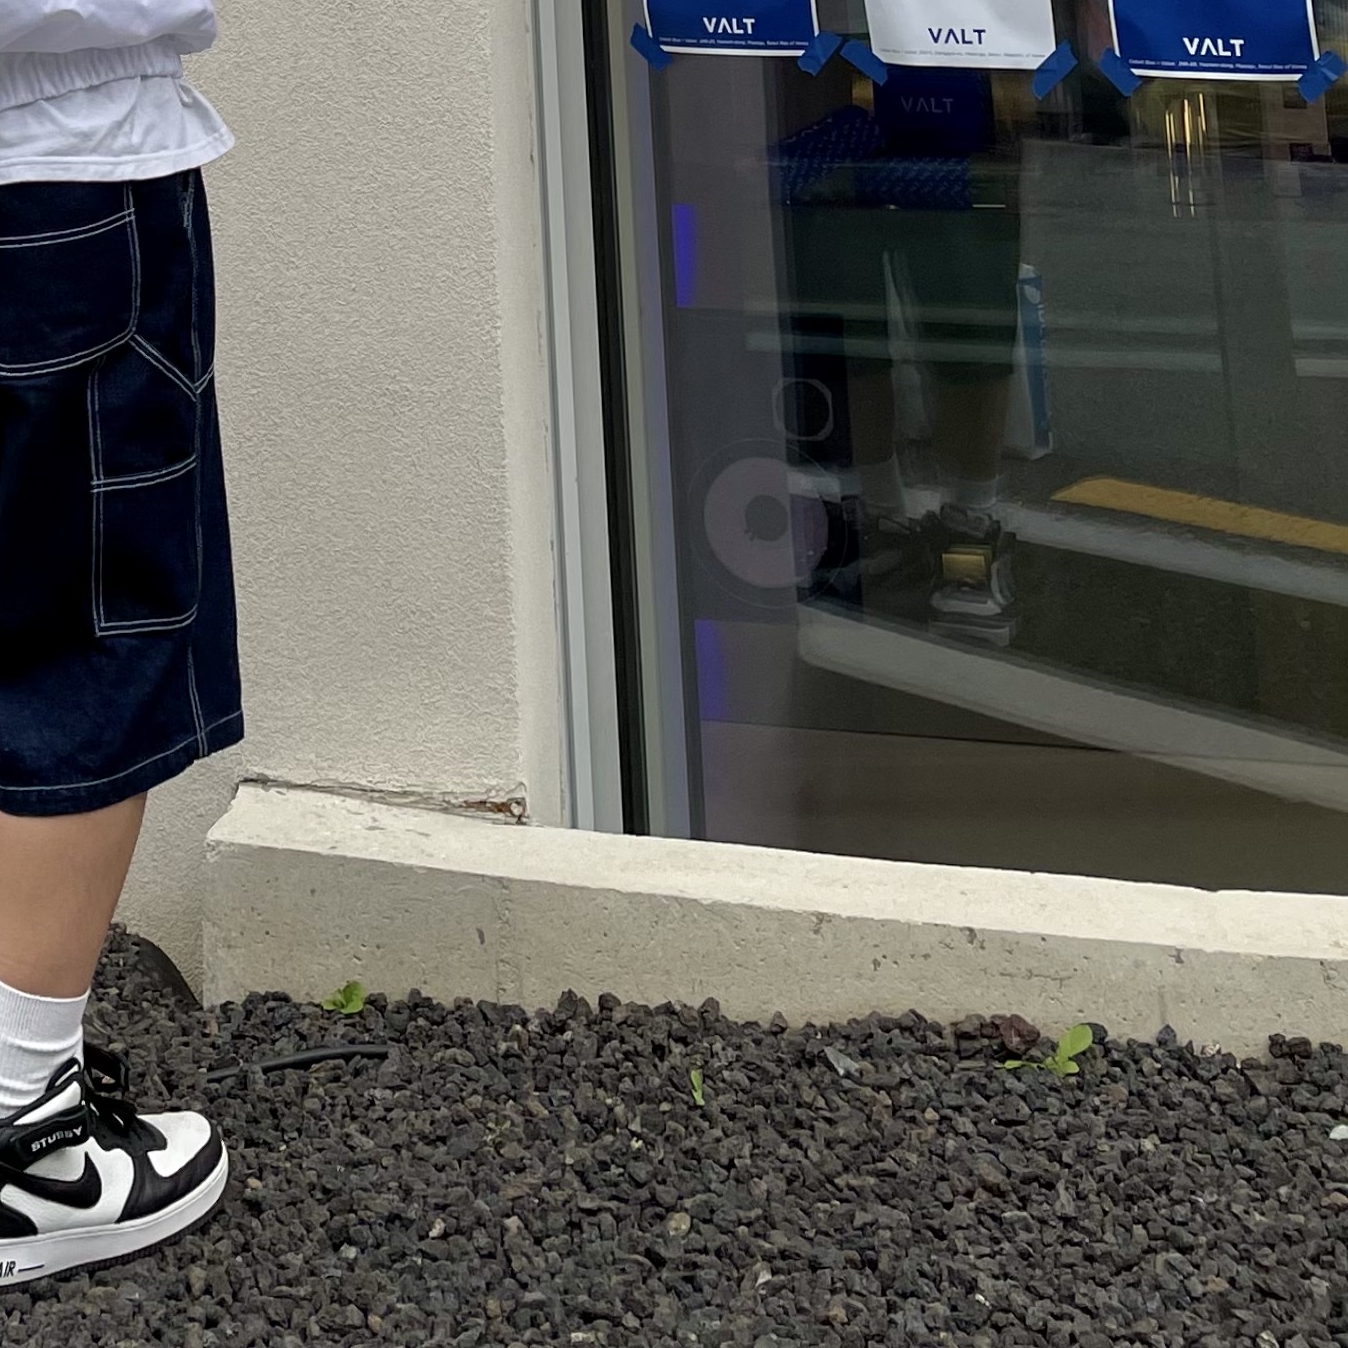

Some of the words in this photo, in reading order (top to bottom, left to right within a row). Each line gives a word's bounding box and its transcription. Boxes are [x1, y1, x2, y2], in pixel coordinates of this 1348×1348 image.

[702, 17, 756, 35] VALT
[927, 27, 987, 45] VALT
[1182, 37, 1245, 57] VALT
[901, 96, 955, 115] VALT
